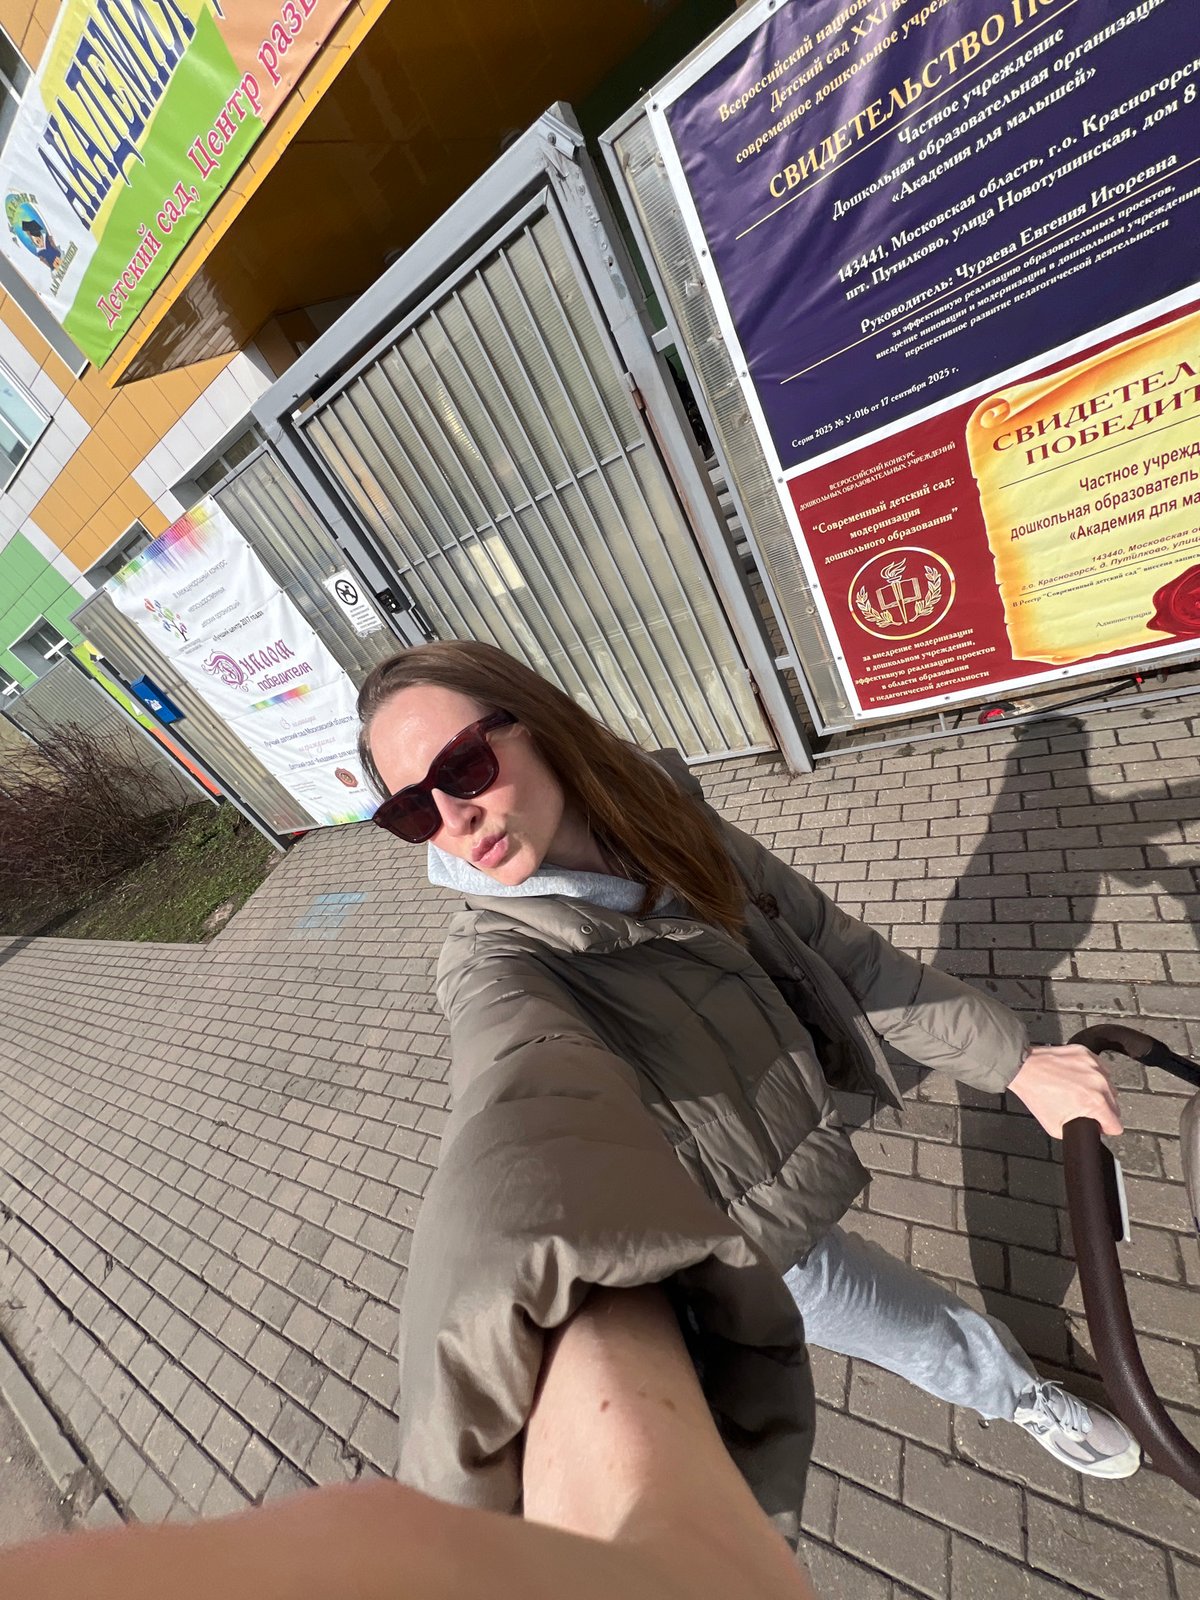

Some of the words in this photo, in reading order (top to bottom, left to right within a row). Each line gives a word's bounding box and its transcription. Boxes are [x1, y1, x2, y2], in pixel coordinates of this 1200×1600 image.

[718, 35, 814, 123] Всероссийский
[815, 0, 872, 44] национ
[769, 57, 824, 113] Детский
[826, 40, 851, 65] сад
[897, 101, 960, 146] Частное
[962, 28, 1065, 109] учреждение
[735, 98, 813, 164] современное
[814, 31, 899, 106] дошкольное
[768, 13, 1006, 198] СВИДЕТЕЛЬСТВО
[832, 157, 916, 221] Дошкольная
[918, 66, 1050, 162] образовательная
[891, 143, 972, 203] «Академия
[975, 126, 1003, 153] для
[1006, 67, 1097, 133] малышей»
[96, 222, 164, 332] Детский
[156, 181, 200, 235] сад,
[187, 72, 262, 182] Центр
[837, 244, 890, 283] 143441,
[890, 194, 976, 252] Московская
[978, 155, 1045, 200] область,
[1047, 137, 1078, 158] г.о.
[844, 282, 871, 301] пгт.
[871, 235, 950, 286] Путилково,
[951, 207, 996, 243] улица
[996, 126, 1138, 213] Новотушинская,
[1142, 99, 1179, 131] дом
[1183, 83, 1197, 104] 8
[860, 275, 954, 334] Руководитель:
[955, 242, 1018, 280] Чураева
[1020, 202, 1087, 249] Евгения
[1090, 153, 1178, 210] Игоревна
[891, 327, 902, 339] за
[902, 296, 963, 333] эффективную
[964, 262, 1022, 303] реализацию
[1023, 217, 1115, 270] образовательных
[1117, 184, 1177, 220] проектов,
[875, 333, 919, 360] внедрение
[920, 306, 968, 337] инновации
[968, 302, 977, 312] и
[976, 263, 1047, 308] модернизации
[1049, 261, 1056, 271] в
[1057, 225, 1126, 268] дошкольном
[904, 321, 969, 359] перспективное
[970, 298, 1012, 330] развитие
[1013, 256, 1093, 306] педагогической
[1094, 218, 1170, 264] деятельности
[791, 433, 815, 448] Серия
[814, 423, 834, 439] 2025
[834, 417, 845, 429] №
[844, 406, 870, 424] У-016
[870, 403, 880, 412] от
[880, 396, 891, 407] 17
[890, 382, 927, 403] сентября
[927, 367, 951, 386] 2025
[951, 366, 960, 375] г.
[992, 354, 1200, 452] СВИДЕТЕЛ
[799, 489, 843, 513] ДОШКОЛЬНЫХ
[842, 464, 907, 494] ОБРАЗОВАТЕЛЬНЫХ
[907, 440, 957, 468] УЧРЕЖДЕНИЙ
[828, 460, 885, 491] ВСЕРОССИЙСКИЙ
[884, 450, 916, 470] КОНКУРС
[888, 483, 932, 510] детский
[931, 476, 956, 492] сад:
[1079, 463, 1140, 493] Частное
[848, 507, 922, 540] модернизация
[1010, 503, 1092, 542] дошкольная
[1069, 508, 1146, 542] «Академия
[1149, 498, 1178, 521] для
[1092, 548, 1127, 563] 143440,
[1128, 529, 1189, 552] Московская
[823, 537, 887, 565] дошкольного
[1038, 565, 1097, 587] Красногорск,
[1110, 545, 1171, 566] Путилково,
[1019, 595, 1042, 607] Реестр
[1095, 571, 1124, 585] детский
[1143, 560, 1174, 572] внесена
[240, 615, 252, 626] 2017
[862, 655, 872, 663] за
[872, 644, 913, 660] внедрение
[913, 627, 974, 649] модернизации
[256, 661, 314, 692] победителя
[854, 667, 906, 686] эффективную
[907, 656, 955, 676] реализацию
[956, 646, 996, 663] проектов
[866, 665, 872, 673] в
[872, 653, 921, 673] дошкольном
[875, 682, 935, 702] педагогической
[935, 669, 991, 689] деятельности
[887, 677, 918, 690] области
[918, 663, 970, 683] образования
